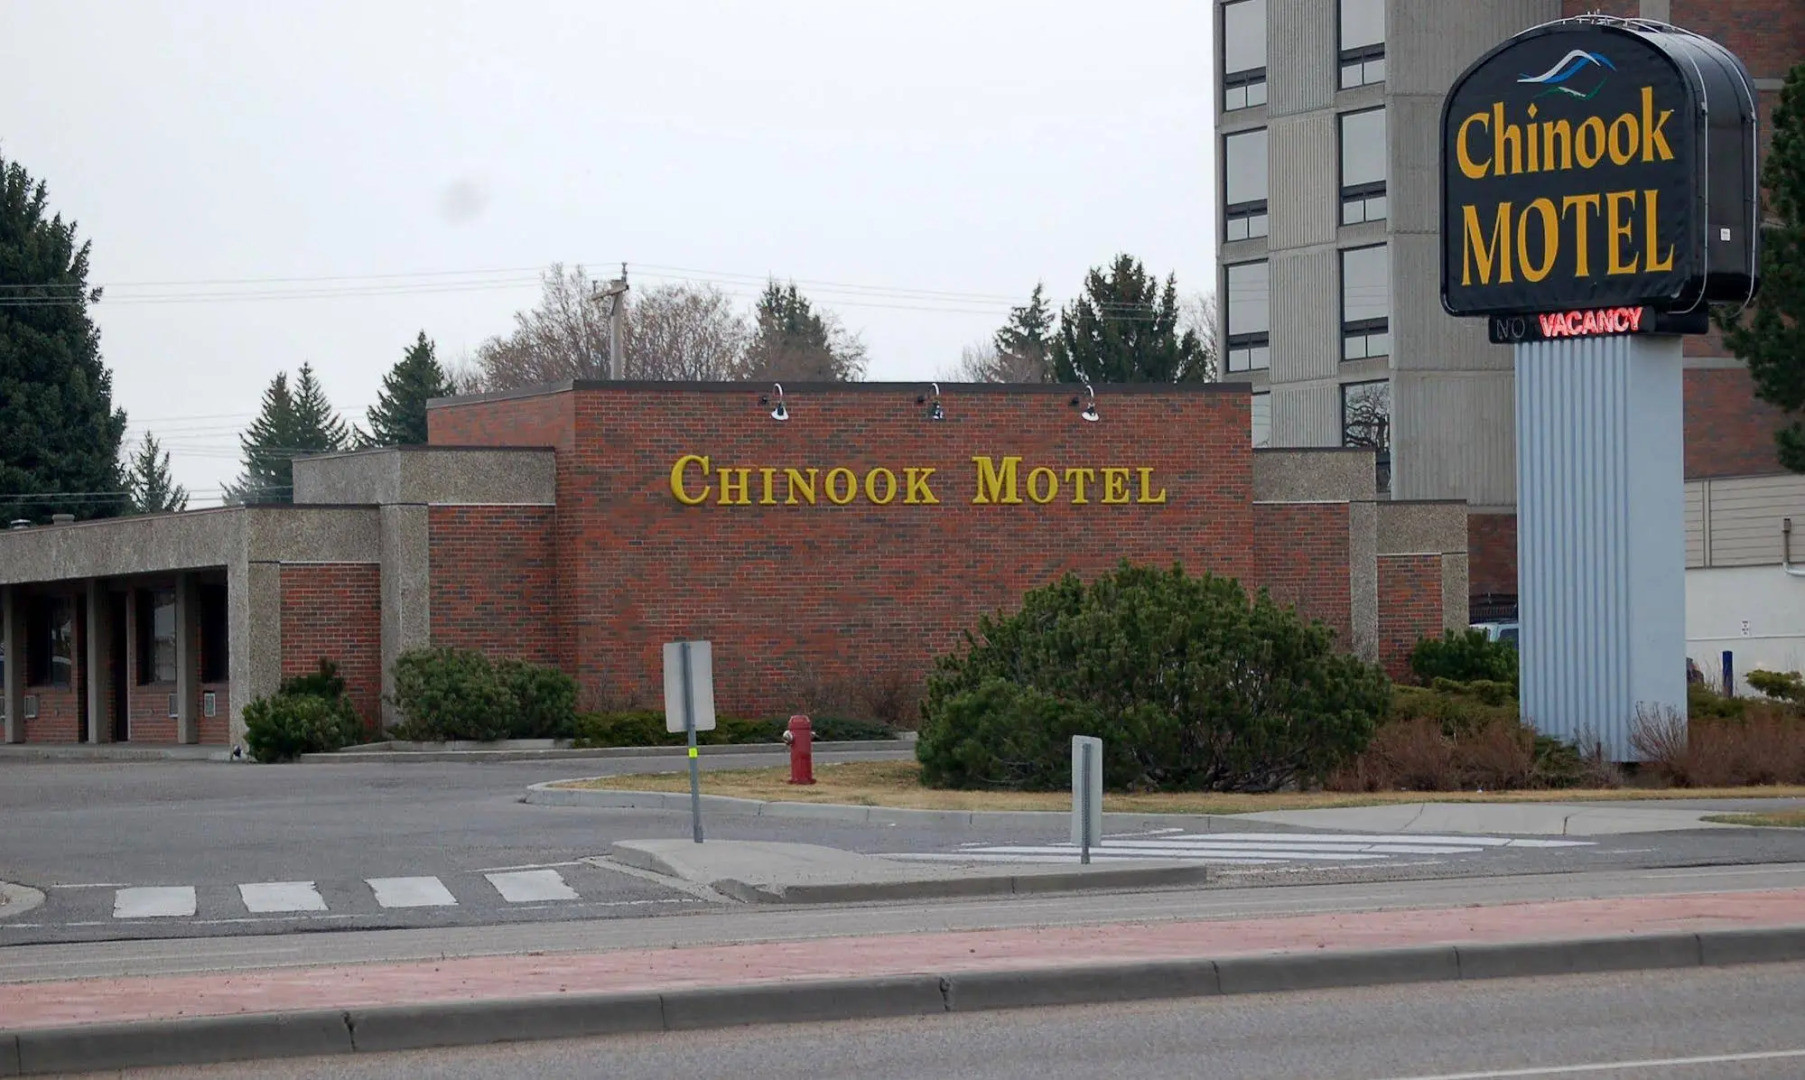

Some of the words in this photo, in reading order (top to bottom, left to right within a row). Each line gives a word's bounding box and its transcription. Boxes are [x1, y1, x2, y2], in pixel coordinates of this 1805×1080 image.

[1456, 86, 1674, 179] Chinook
[1461, 189, 1675, 286] MOTEL
[1496, 316, 1526, 340] NO
[1539, 306, 1645, 338] VACANCY
[670, 454, 940, 505] CHINOOK
[971, 455, 1167, 504] MOTEL
